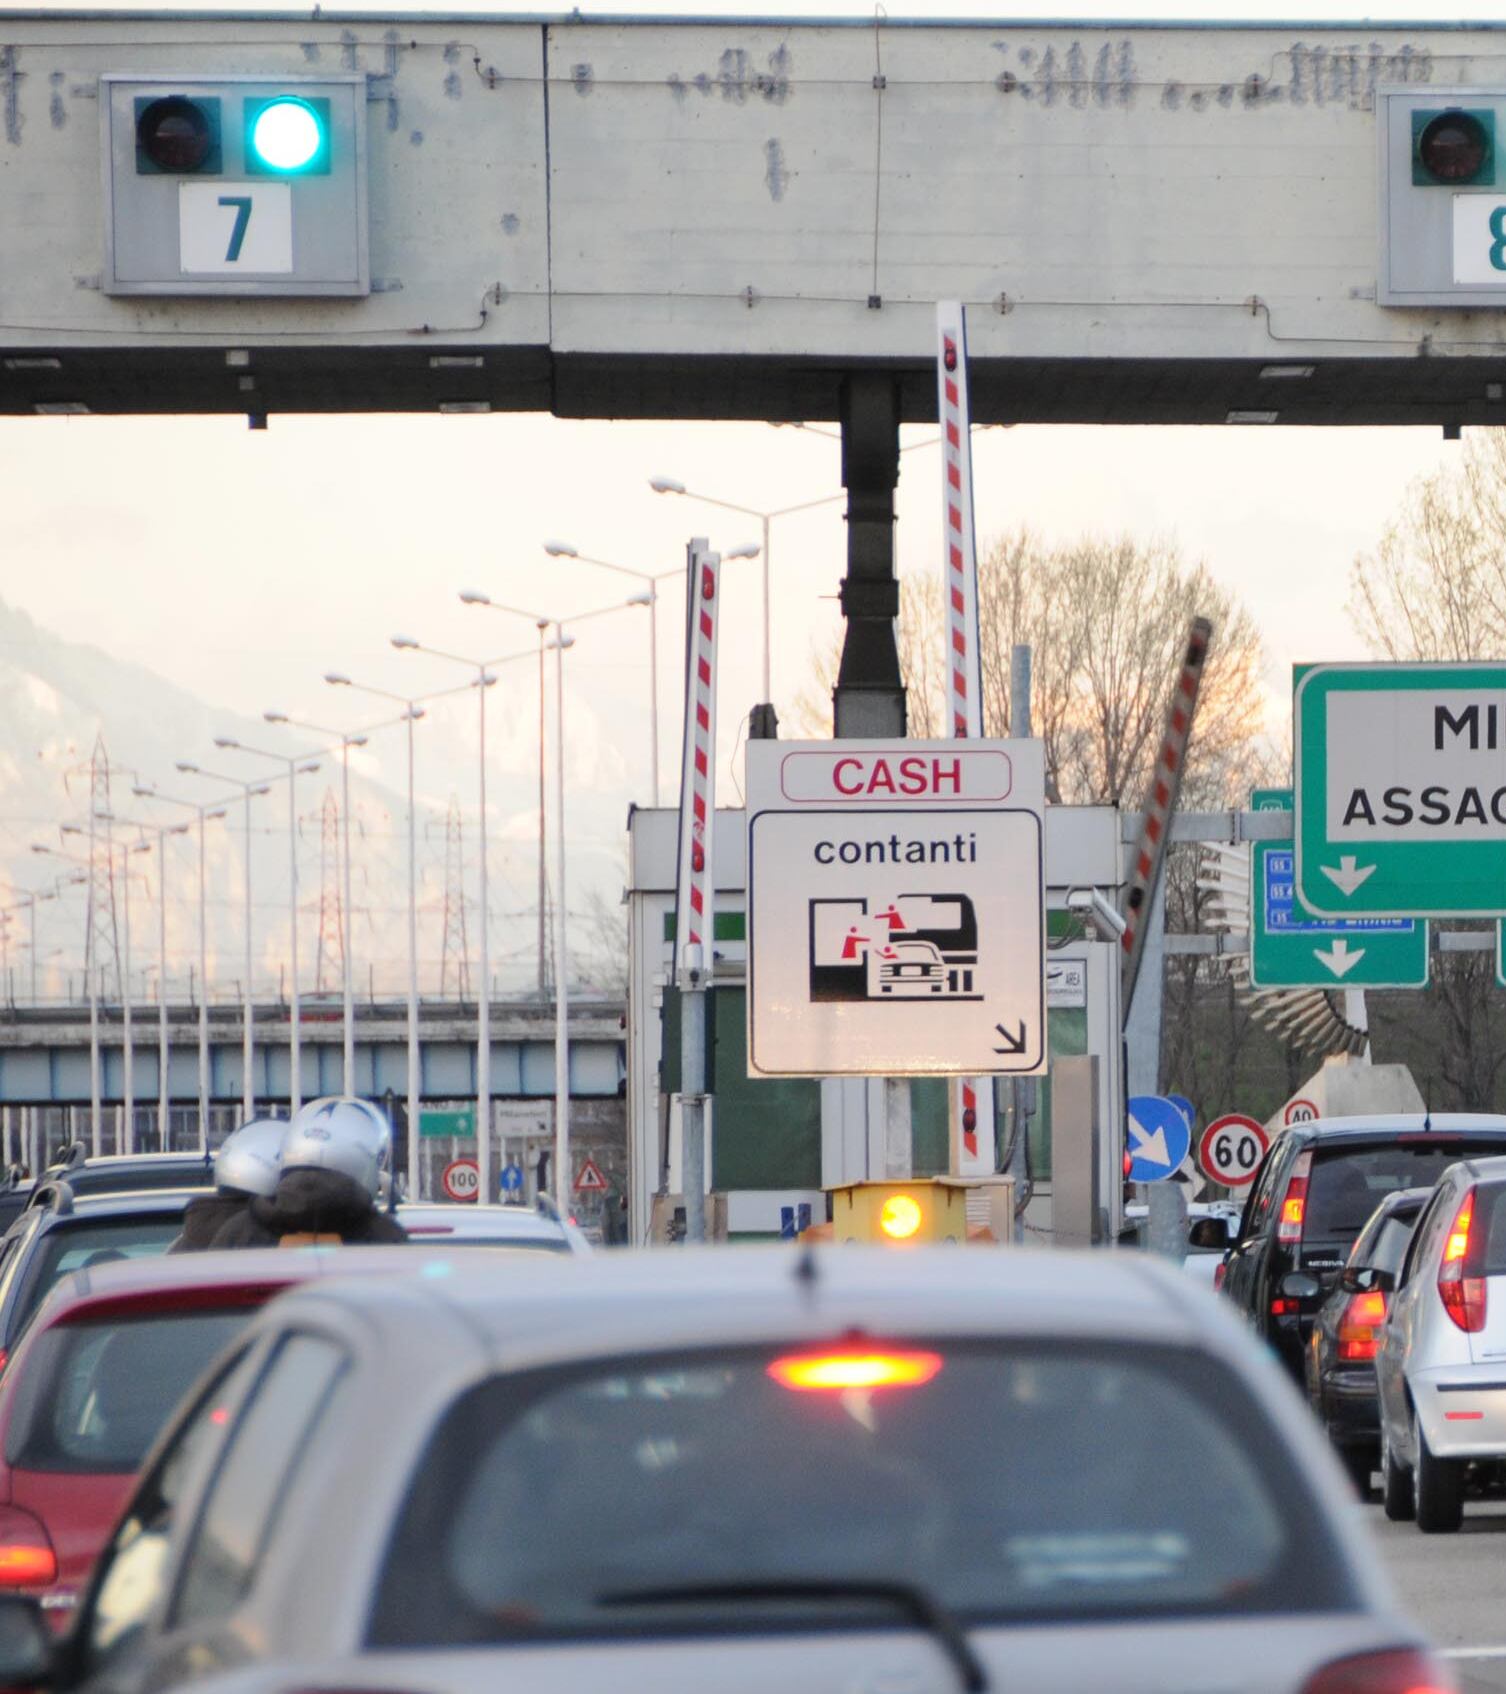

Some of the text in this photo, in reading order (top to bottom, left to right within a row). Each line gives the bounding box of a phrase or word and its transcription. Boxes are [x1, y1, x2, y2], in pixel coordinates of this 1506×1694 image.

[217, 196, 253, 262] 7
[832, 757, 962, 795] CASH
[813, 832, 977, 864] contanti
[1292, 1110, 1311, 1122] 40
[1215, 1135, 1257, 1169] 60
[450, 1172, 478, 1188] 100
